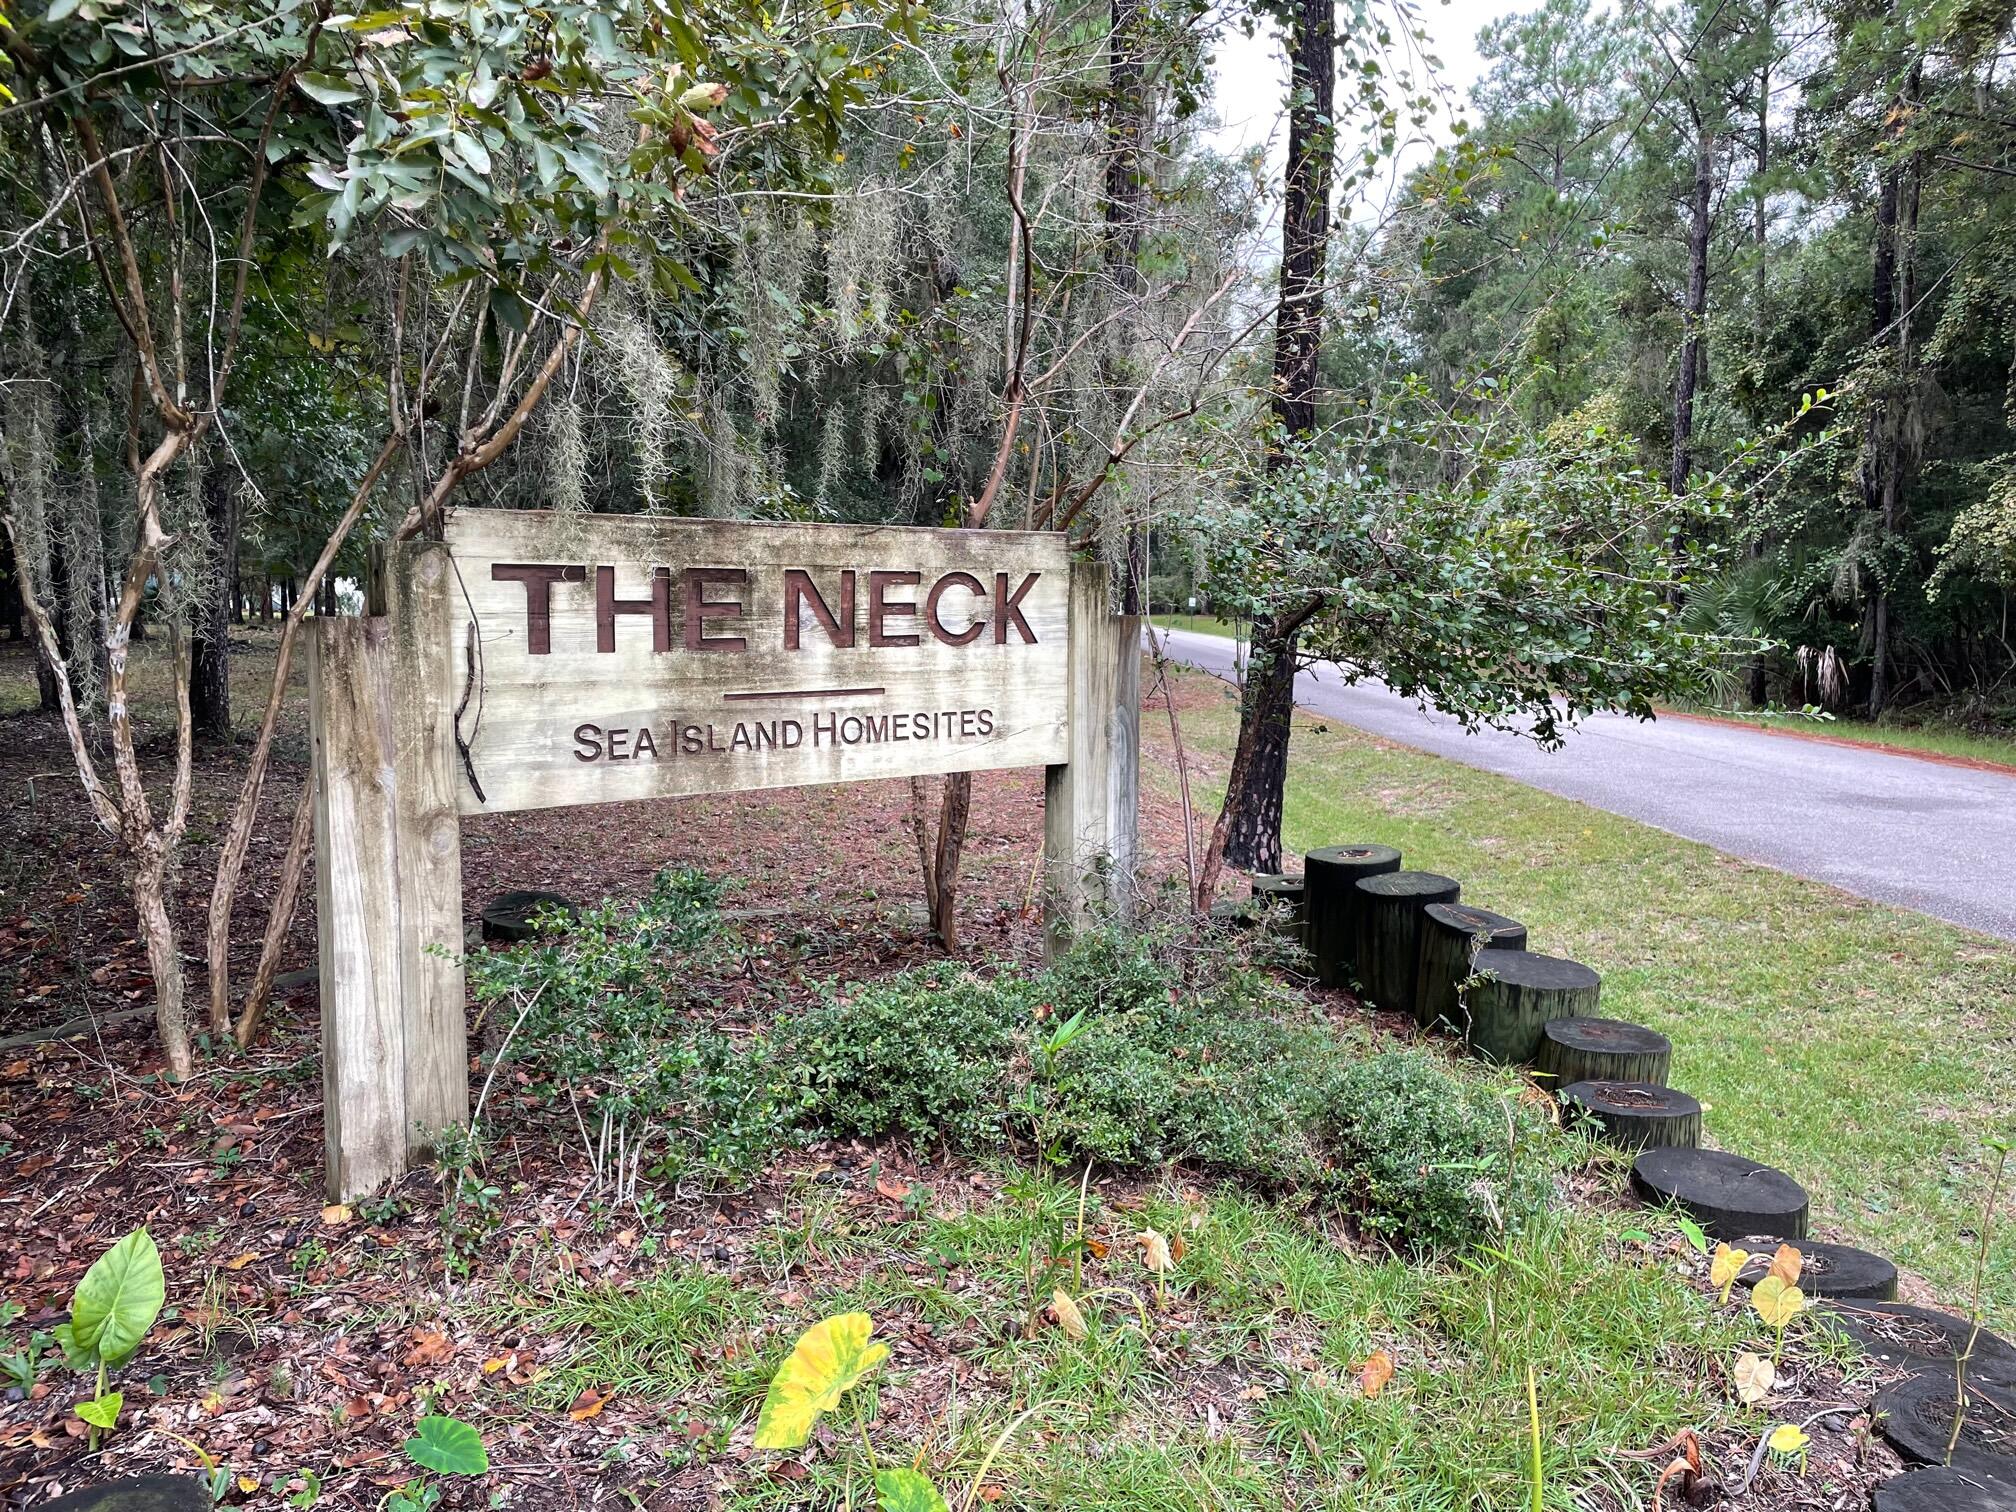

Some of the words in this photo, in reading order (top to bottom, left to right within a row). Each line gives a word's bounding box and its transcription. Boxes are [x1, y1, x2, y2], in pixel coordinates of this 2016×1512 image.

[491, 563, 746, 655] THE
[783, 568, 1042, 650] NECK
[573, 723, 658, 762] SEA
[669, 719, 803, 756] ISLAND
[812, 708, 994, 748] HOMESITES
